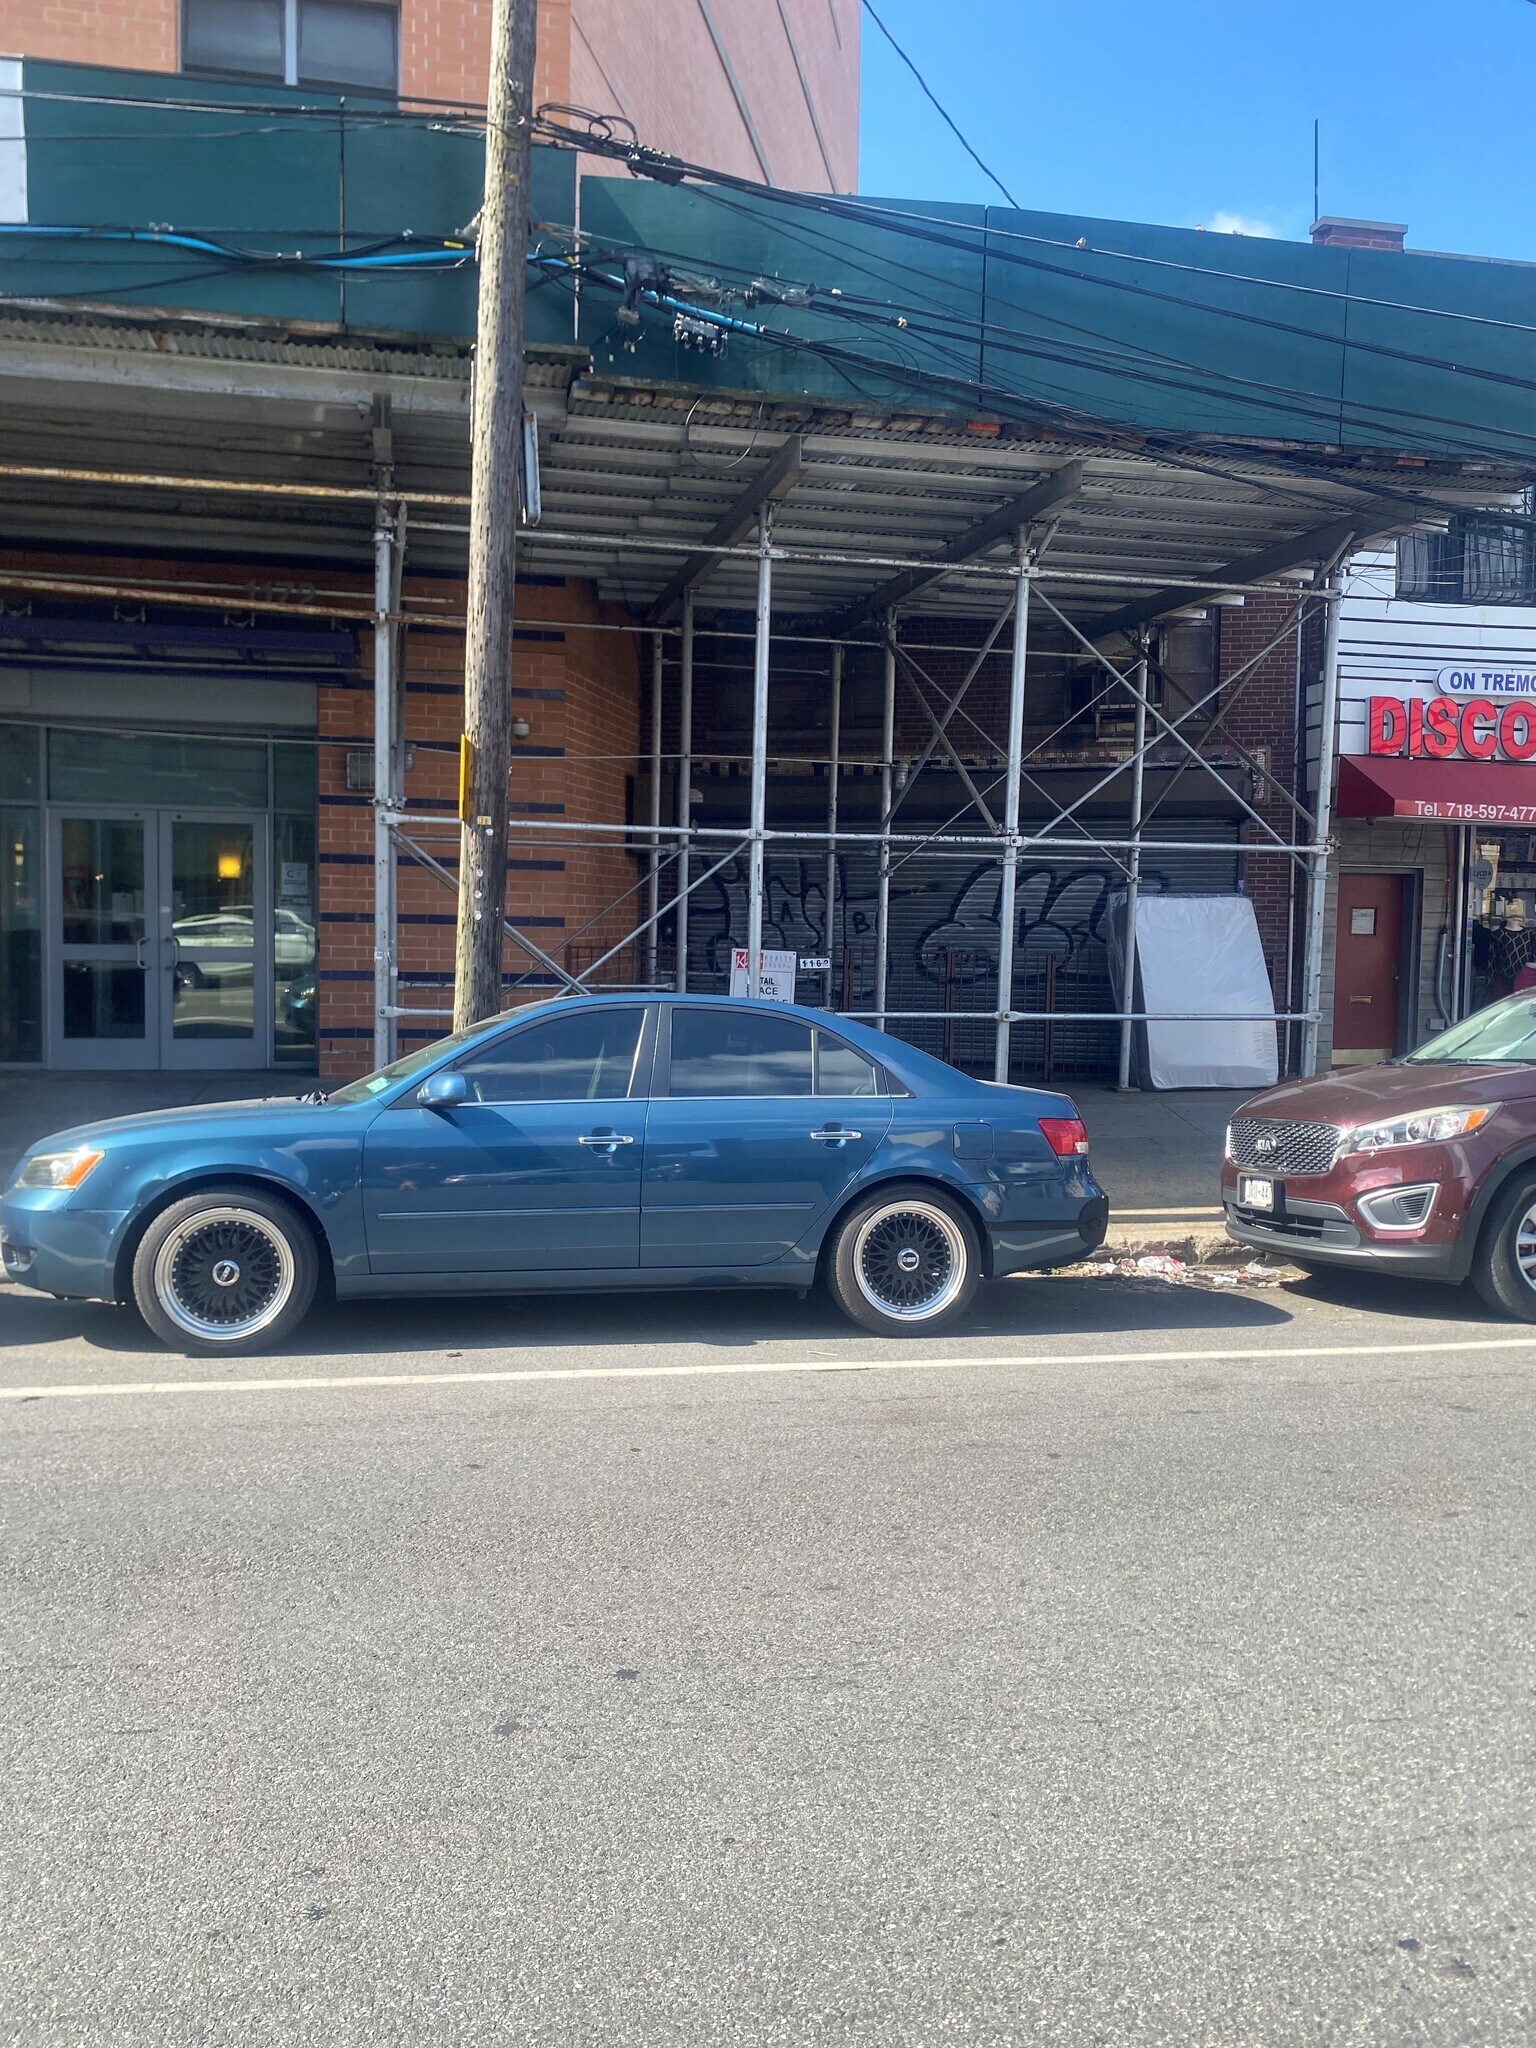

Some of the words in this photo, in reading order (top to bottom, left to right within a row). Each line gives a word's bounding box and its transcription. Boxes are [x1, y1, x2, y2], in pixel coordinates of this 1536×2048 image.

[1449, 671, 1476, 690] ON
[1369, 695, 1536, 760] DISCO
[1414, 800, 1442, 816] Tel.
[1446, 802, 1536, 821] 718-597-477
[764, 954, 793, 963] REALTY
[760, 977, 775, 986] TAIL
[1256, 1139, 1273, 1151] KIA
